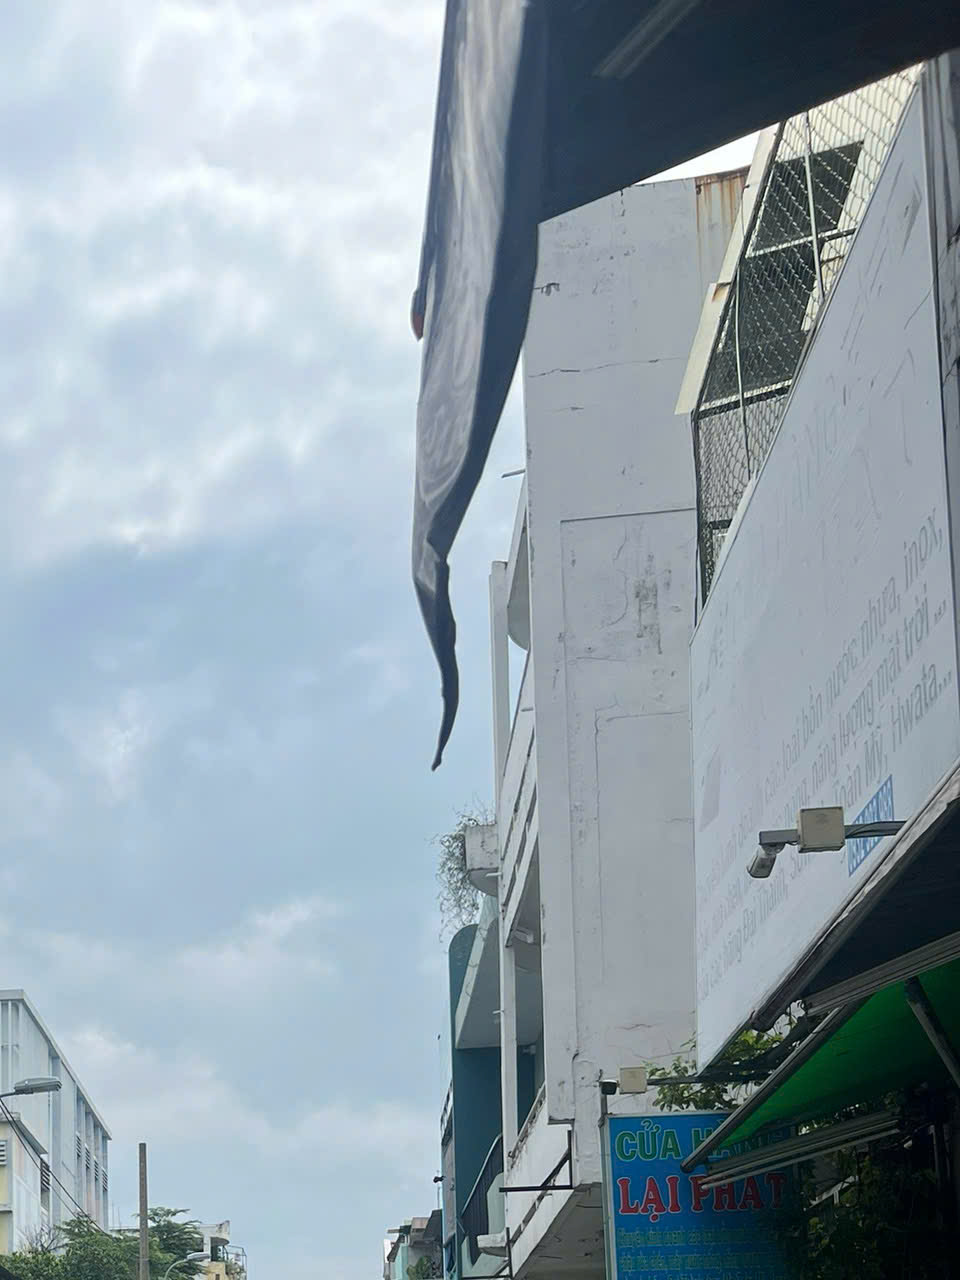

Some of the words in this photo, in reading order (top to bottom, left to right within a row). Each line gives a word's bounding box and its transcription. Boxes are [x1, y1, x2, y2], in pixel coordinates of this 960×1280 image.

[801, 684, 823, 747] bồn
[825, 640, 859, 709] nước
[860, 575, 902, 661] nhựa,
[903, 506, 944, 592] inox,
[838, 673, 874, 751] lượng
[877, 636, 902, 703] mặt
[903, 583, 929, 667] trời
[864, 727, 888, 787] Mỹ,
[890, 661, 952, 753] Hwata...
[615, 1118, 682, 1161] CỬA
[616, 1174, 681, 1223] LẠI
